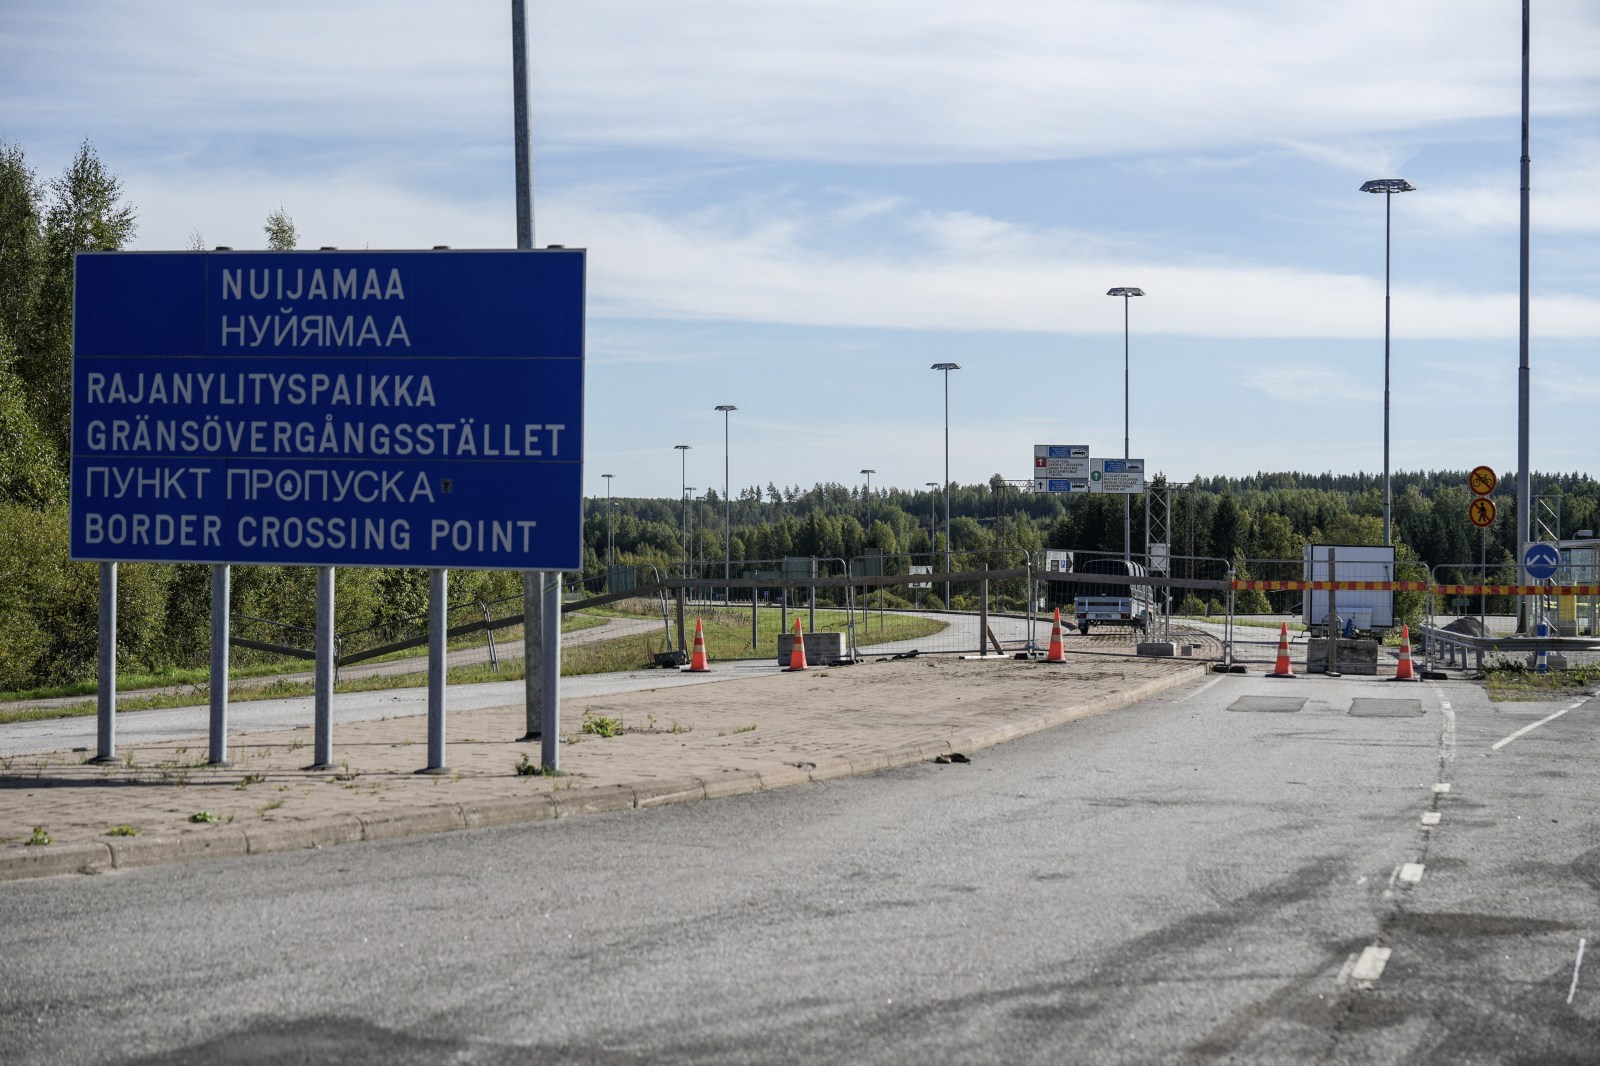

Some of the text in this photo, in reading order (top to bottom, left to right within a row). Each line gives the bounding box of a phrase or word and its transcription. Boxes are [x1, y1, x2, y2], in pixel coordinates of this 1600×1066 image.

[224, 269, 404, 299] NUIJAMAA
[223, 308, 410, 346] НУЙЯМАА
[89, 374, 435, 405] RAJANYLITYSPAIKKA
[88, 415, 564, 455] GRÄNSÖVERGÅNGSSTÄLLET
[88, 468, 433, 502] ПУНКТ ПРОПУСКА
[87, 514, 535, 551] BORDER CROSSING POINT
